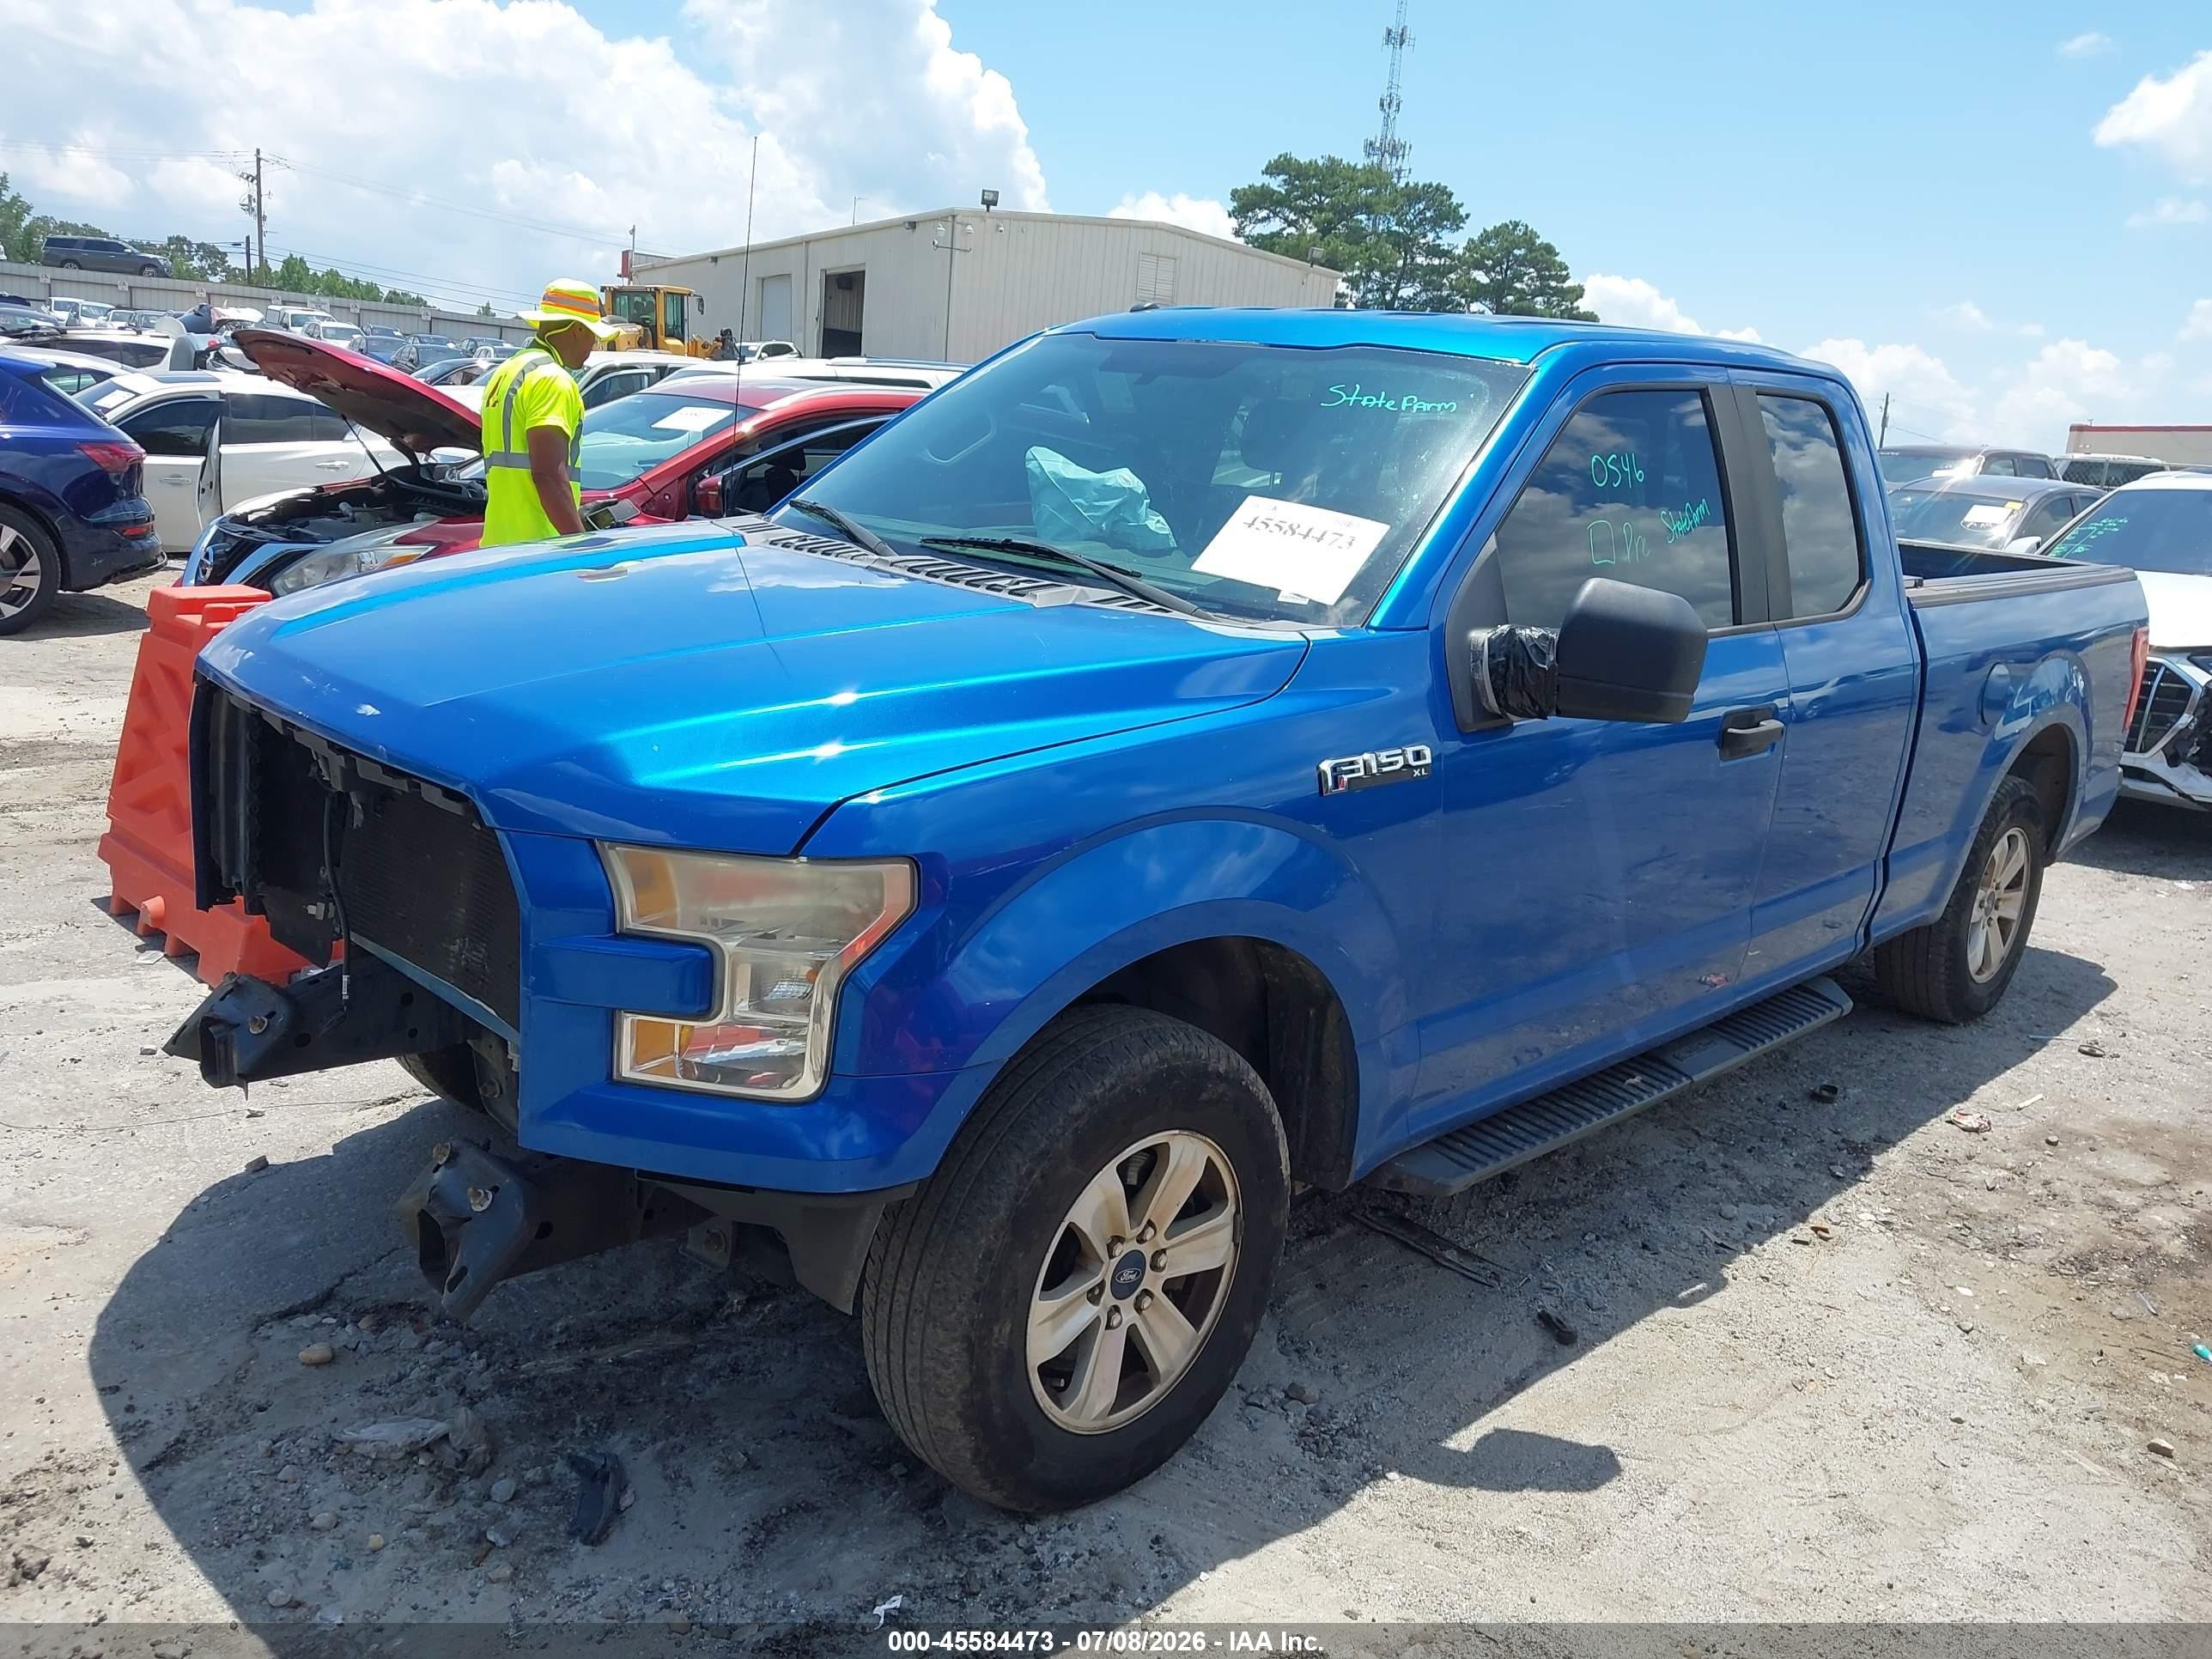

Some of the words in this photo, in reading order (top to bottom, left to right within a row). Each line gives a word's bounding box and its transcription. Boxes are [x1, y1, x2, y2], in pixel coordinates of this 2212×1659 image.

[1243, 515, 1357, 550] 45584473
[1413, 768, 1430, 778] XL
[1120, 1270, 1138, 1282] Ford
